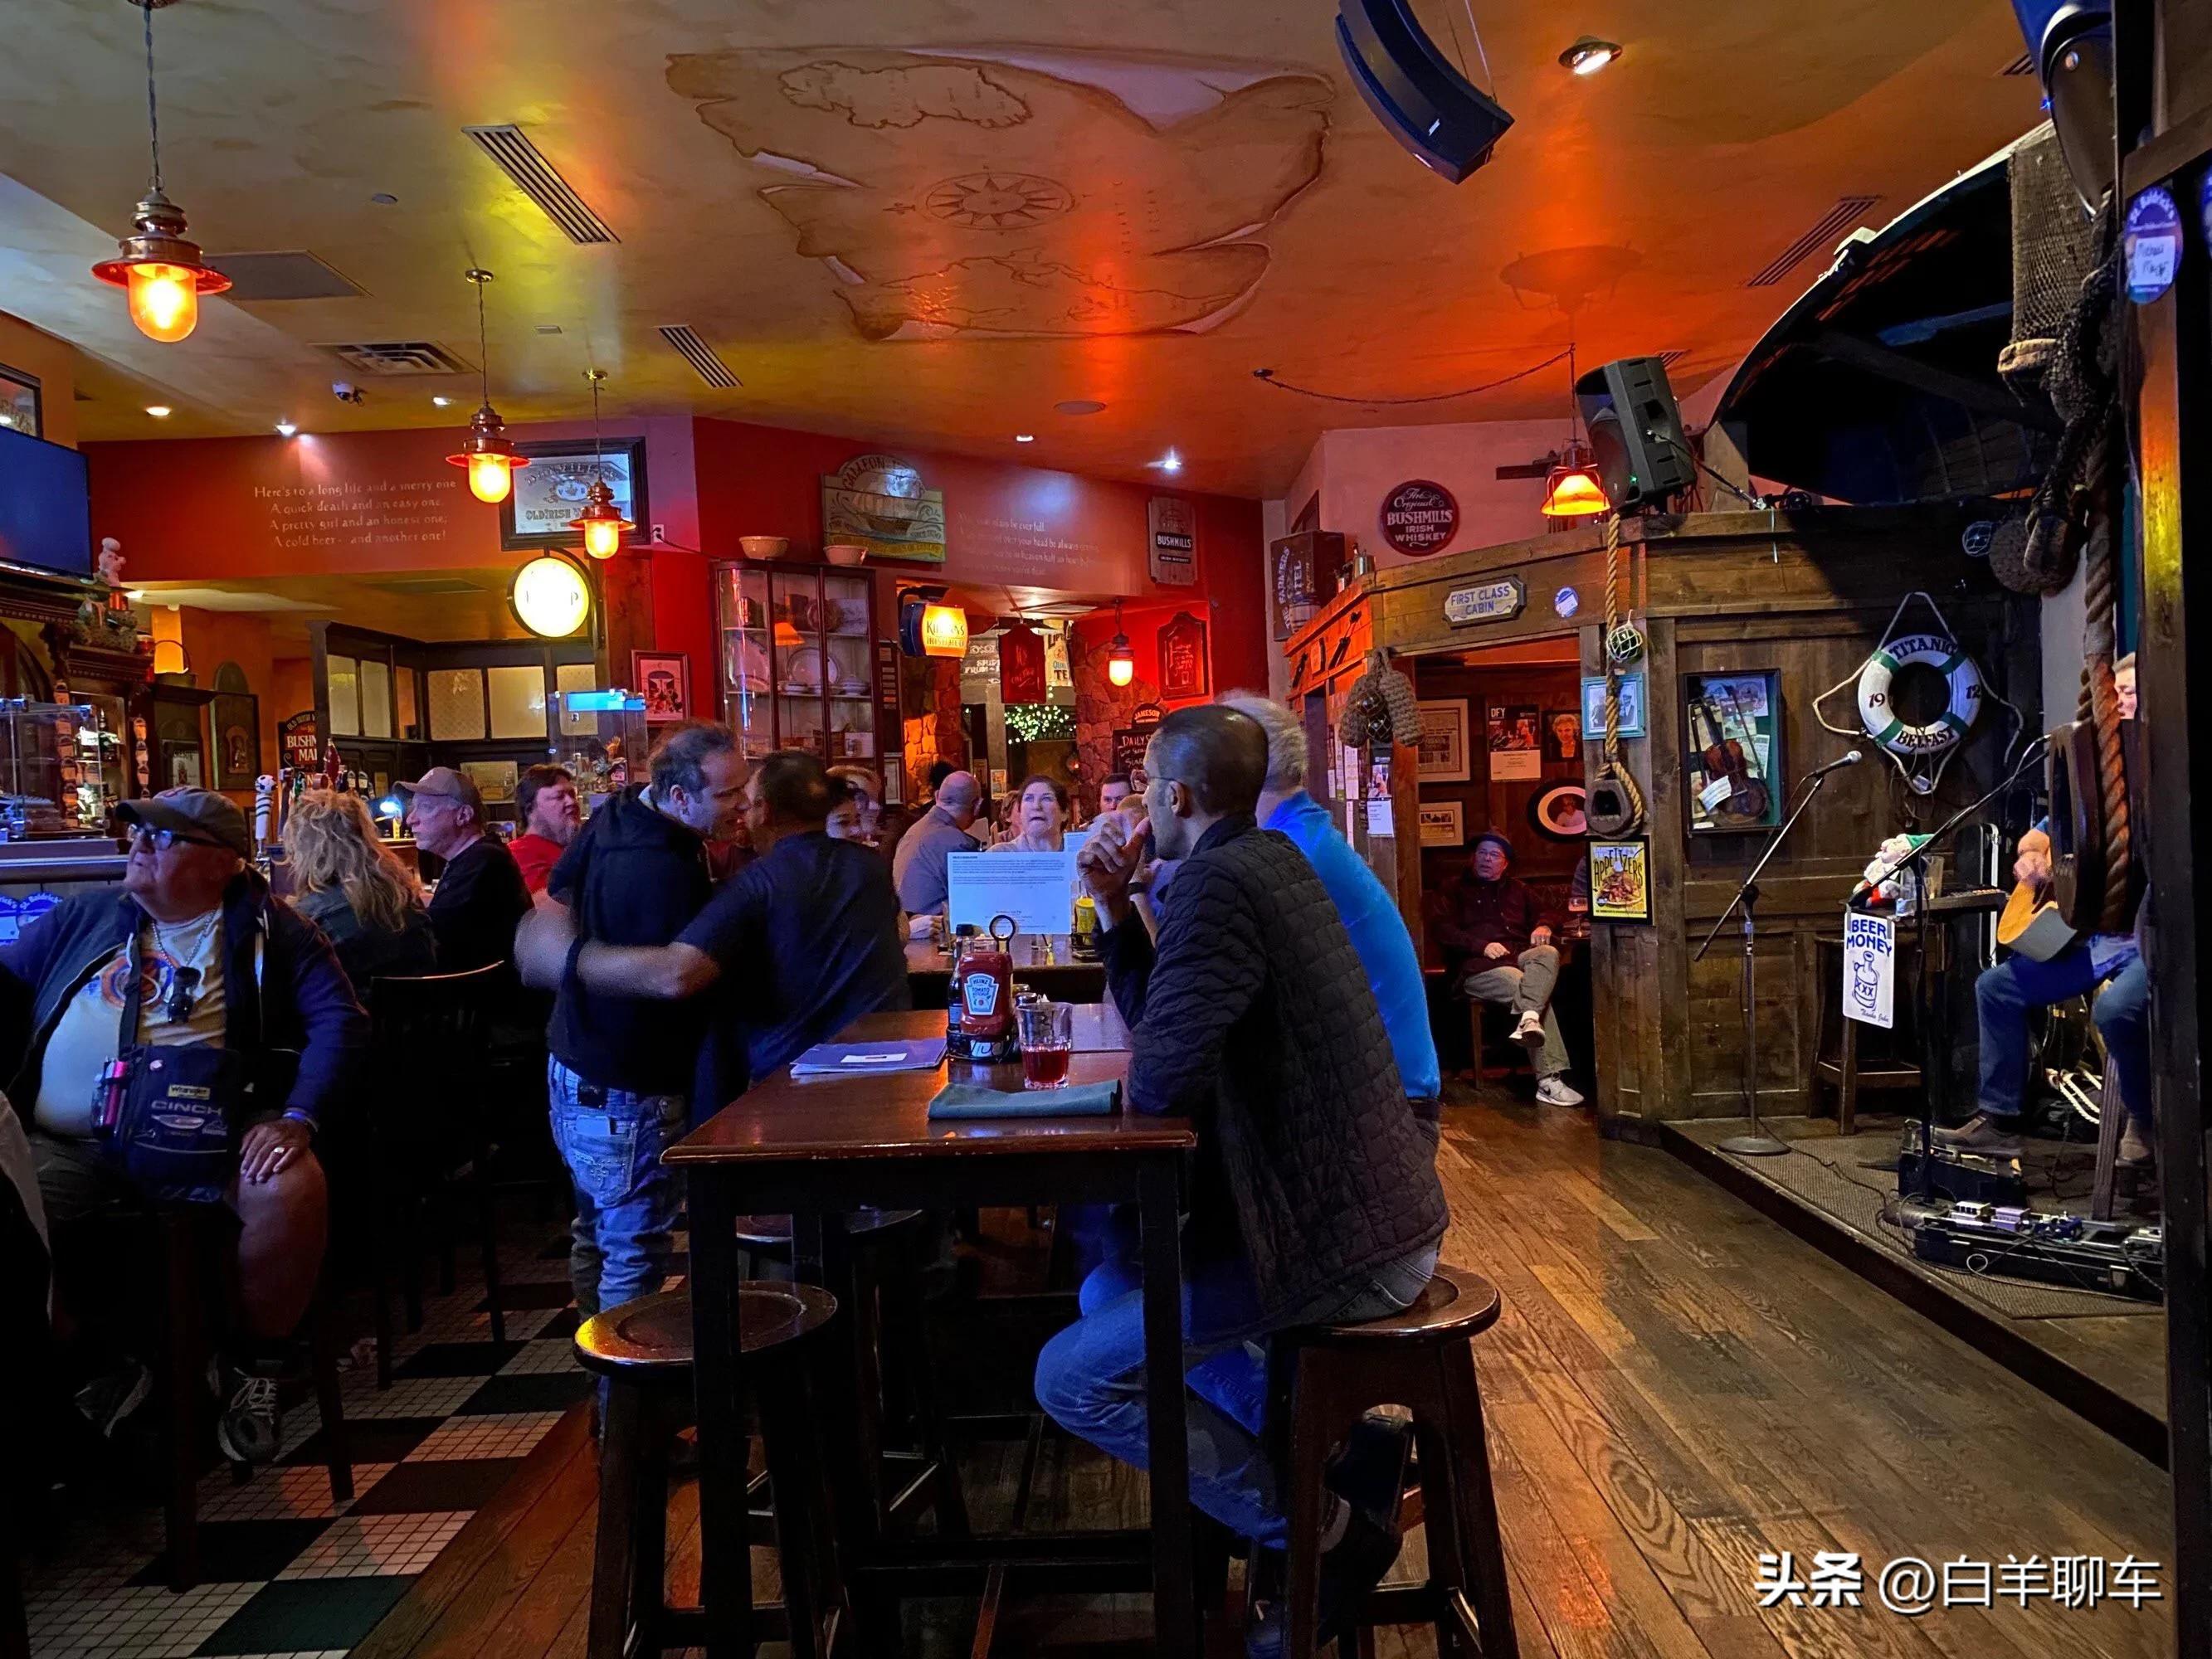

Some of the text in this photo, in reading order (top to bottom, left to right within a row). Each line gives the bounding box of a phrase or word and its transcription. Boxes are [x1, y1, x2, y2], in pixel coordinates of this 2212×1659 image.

[254, 486, 290, 498] Here's
[293, 488, 306, 497] to
[318, 484, 343, 497] long
[344, 483, 362, 494] life
[399, 480, 432, 492] merry
[1406, 488, 1425, 499] The
[270, 503, 282, 514] A
[284, 501, 313, 515] quick
[316, 500, 348, 513] death
[352, 500, 373, 511] and
[392, 500, 417, 511] easy
[1394, 497, 1435, 512] Original
[270, 519, 280, 531] A
[282, 521, 315, 533] pretty
[319, 518, 339, 531] girl
[342, 515, 363, 528] and
[366, 518, 381, 527] an
[383, 515, 421, 526] honest
[1387, 509, 1453, 526] BUSHMILLS
[1406, 524, 1435, 533] IRISH
[273, 536, 283, 547] A
[285, 535, 309, 547] cold
[351, 533, 372, 544] and
[373, 532, 417, 543] another
[1033, 538, 1048, 547] head
[1049, 538, 1056, 547] be
[1157, 535, 1191, 548] BUSHMILLS
[1395, 532, 1446, 542] WHISKEY
[1278, 546, 1290, 604] FARMERS
[1451, 585, 1510, 605] FIRST CLASS
[1465, 602, 1494, 615] CABIN
[1888, 637, 1958, 659] TITANIC
[1966, 684, 1981, 699] 12
[1869, 693, 1886, 708] 19
[1134, 709, 1160, 721] JAMESON
[1491, 708, 1506, 718] DFY
[1122, 736, 1145, 747] DAILY
[1895, 730, 1954, 748] BELFAST
[1594, 848, 1644, 888] APPETIZERS
[1852, 919, 1887, 939] BEER
[1846, 934, 1892, 957] MONEY
[1855, 979, 1873, 997] XXX
[151, 1100, 222, 1116] CINCH
